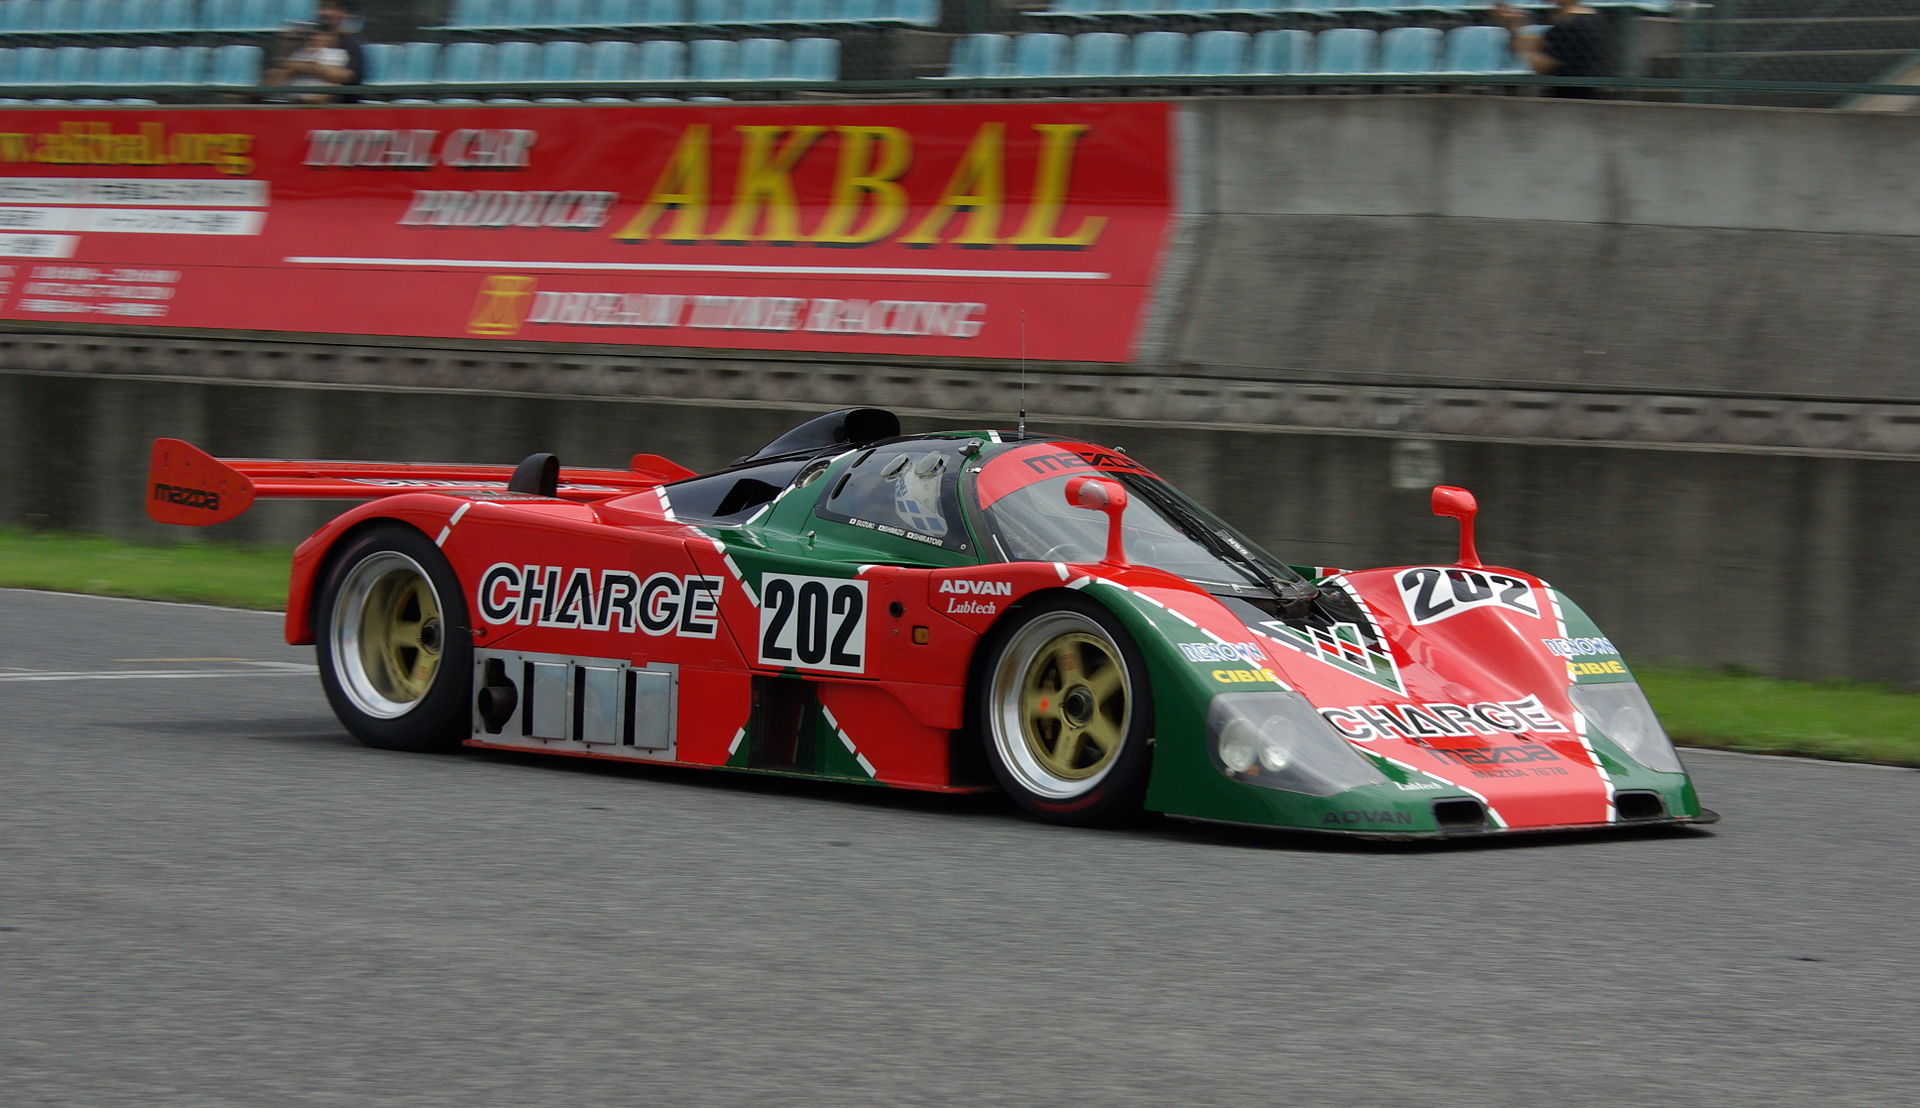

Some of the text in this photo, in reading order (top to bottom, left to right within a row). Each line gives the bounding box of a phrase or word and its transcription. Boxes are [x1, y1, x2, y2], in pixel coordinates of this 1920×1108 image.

[302, 128, 538, 167] TOTAL CAR
[610, 122, 1110, 245] AKBAL
[395, 189, 620, 228] PRODUCE
[801, 299, 987, 337] RACING
[912, 533, 944, 547] SHIRATORI
[939, 579, 1012, 597] ADVAN
[1401, 567, 1538, 622] 202
[477, 562, 725, 640] CHARGE
[946, 597, 997, 615] Lubtech
[761, 577, 865, 668] 202
[1177, 642, 1268, 662] RENOWN
[1540, 637, 1620, 657] RENOWN
[1211, 668, 1281, 683] CIBIE
[1567, 660, 1628, 675] CIBIE
[1318, 693, 1570, 742] CHARGE
[1472, 767, 1527, 779] MAZDA
[1322, 809, 1414, 825] ADVAN
